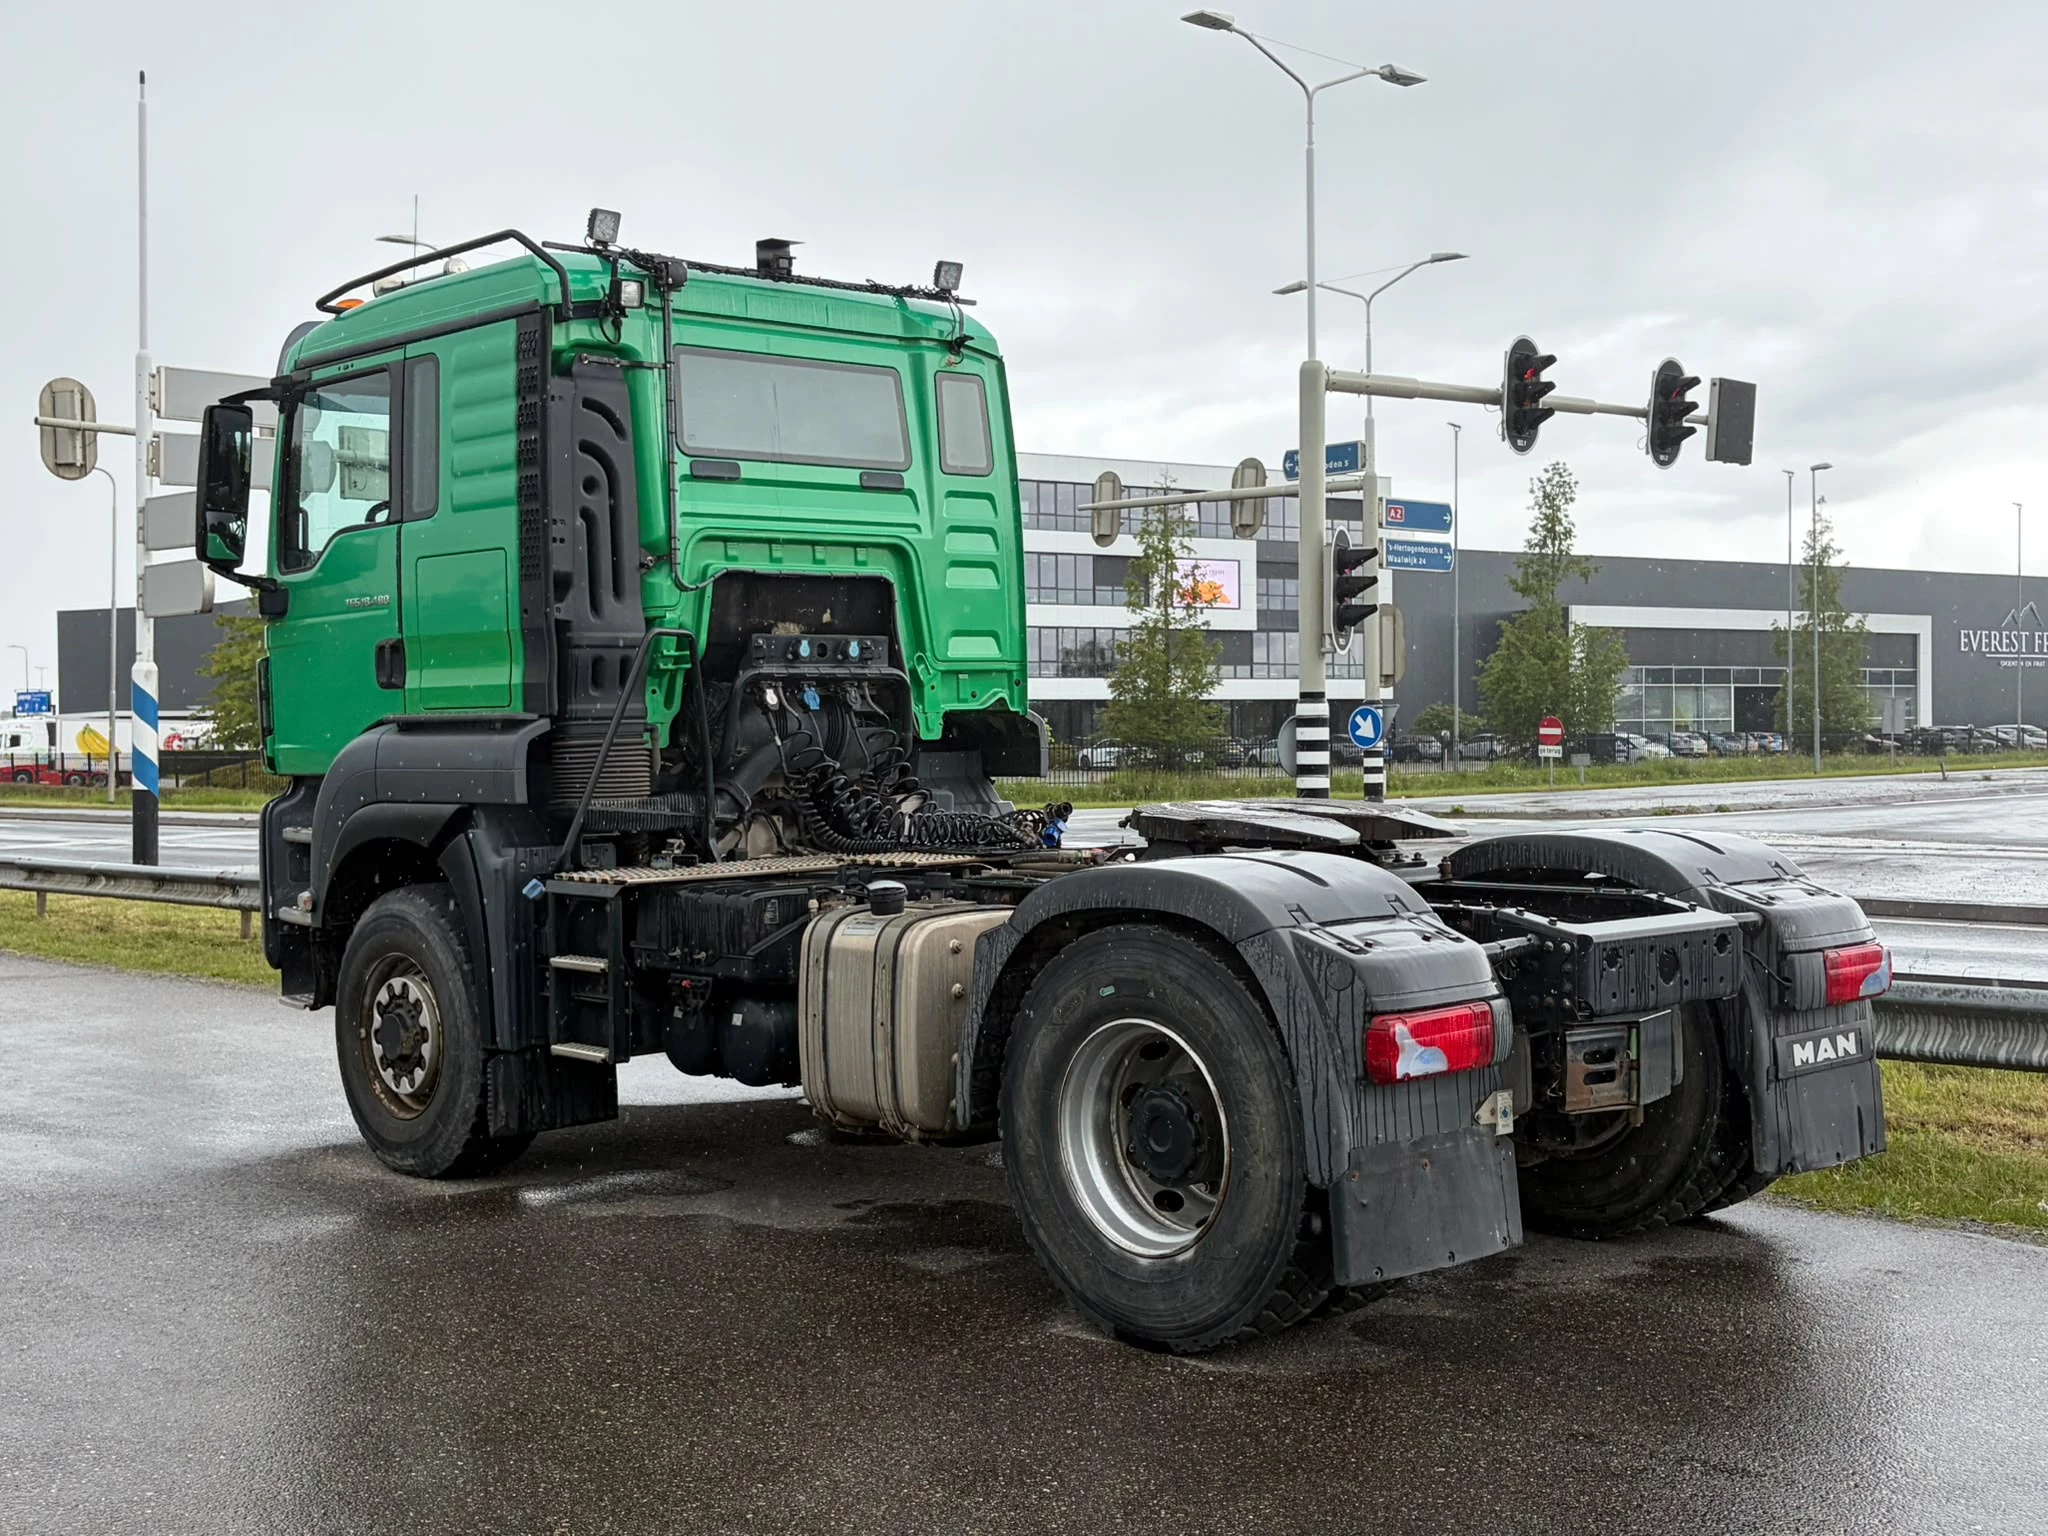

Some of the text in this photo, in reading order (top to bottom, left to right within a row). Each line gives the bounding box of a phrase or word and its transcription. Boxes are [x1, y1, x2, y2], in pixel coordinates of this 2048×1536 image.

[1389, 508, 1403, 519] A2
[1387, 542, 1439, 555] 's-Hertogenbosch
[1387, 554, 1427, 567] Waalwijk 24
[1960, 630, 2029, 652] EVEREST
[1792, 1031, 1857, 1067] MAN
